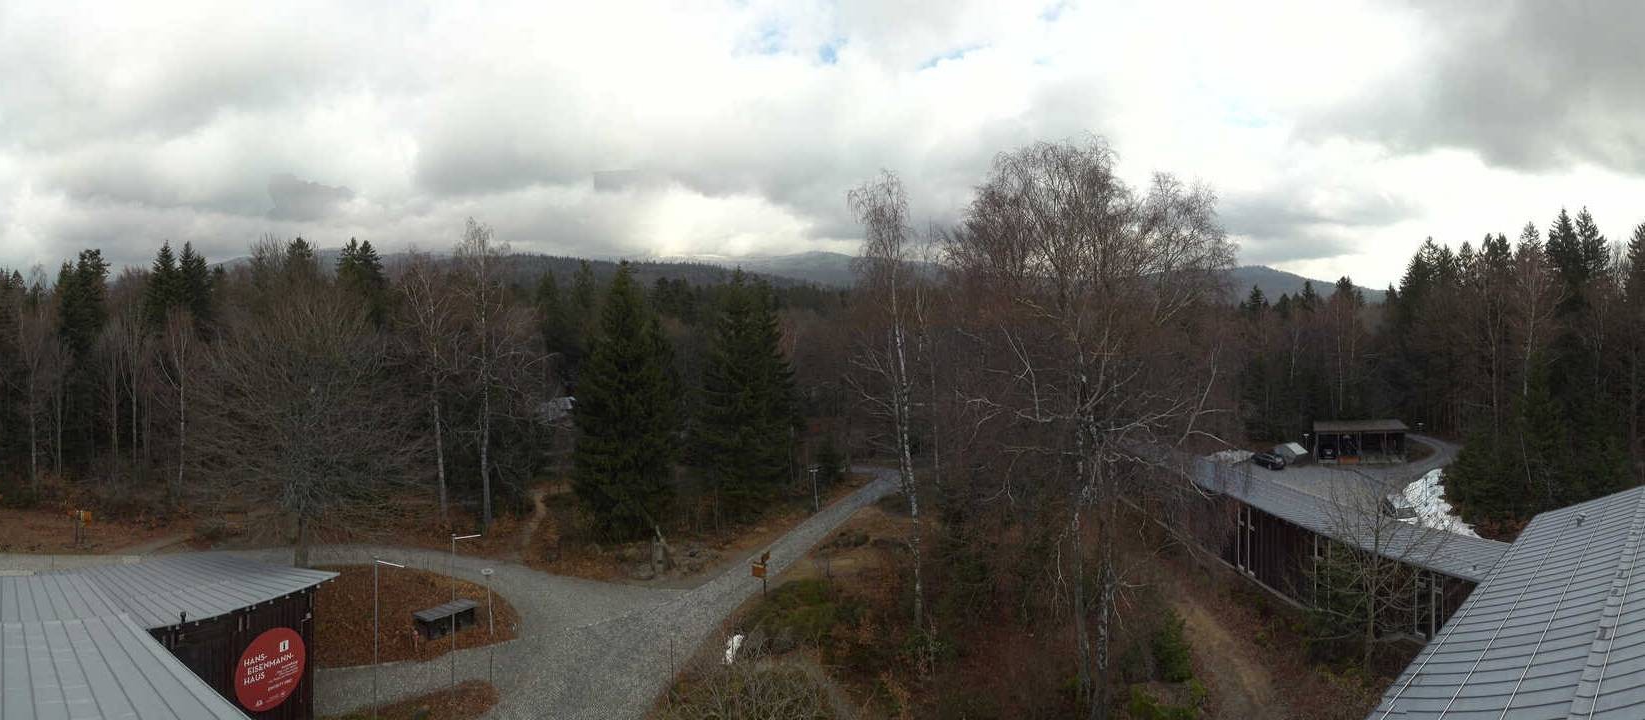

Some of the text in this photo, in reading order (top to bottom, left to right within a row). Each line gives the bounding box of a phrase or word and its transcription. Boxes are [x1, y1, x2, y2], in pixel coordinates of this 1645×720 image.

[244, 653, 268, 667] HANS-
[248, 653, 295, 675] EISENMANN-
[244, 671, 265, 686] HAUS
